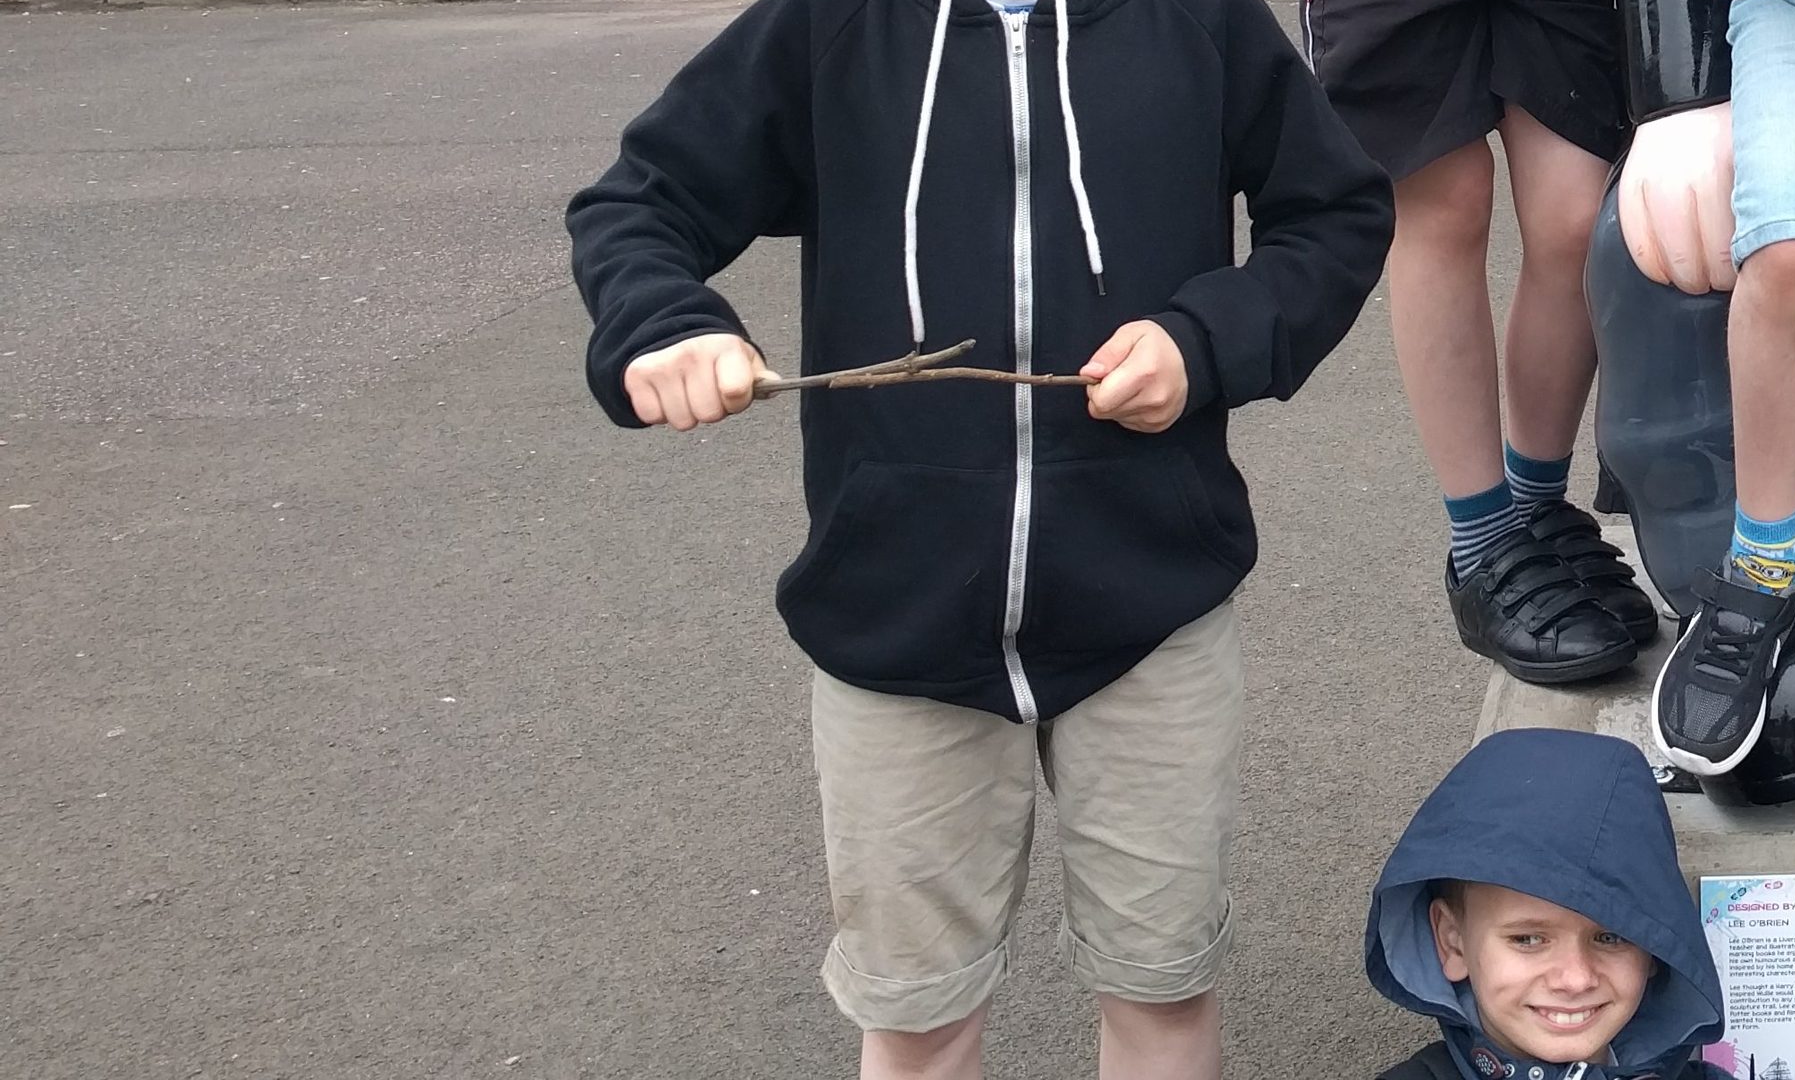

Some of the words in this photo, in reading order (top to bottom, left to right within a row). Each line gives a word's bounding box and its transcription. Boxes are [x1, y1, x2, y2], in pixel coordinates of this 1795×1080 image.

[1728, 903, 1779, 912] DESIGNED
[1729, 920, 1745, 928] LEE
[1749, 919, 1789, 927] O'BRIEN
